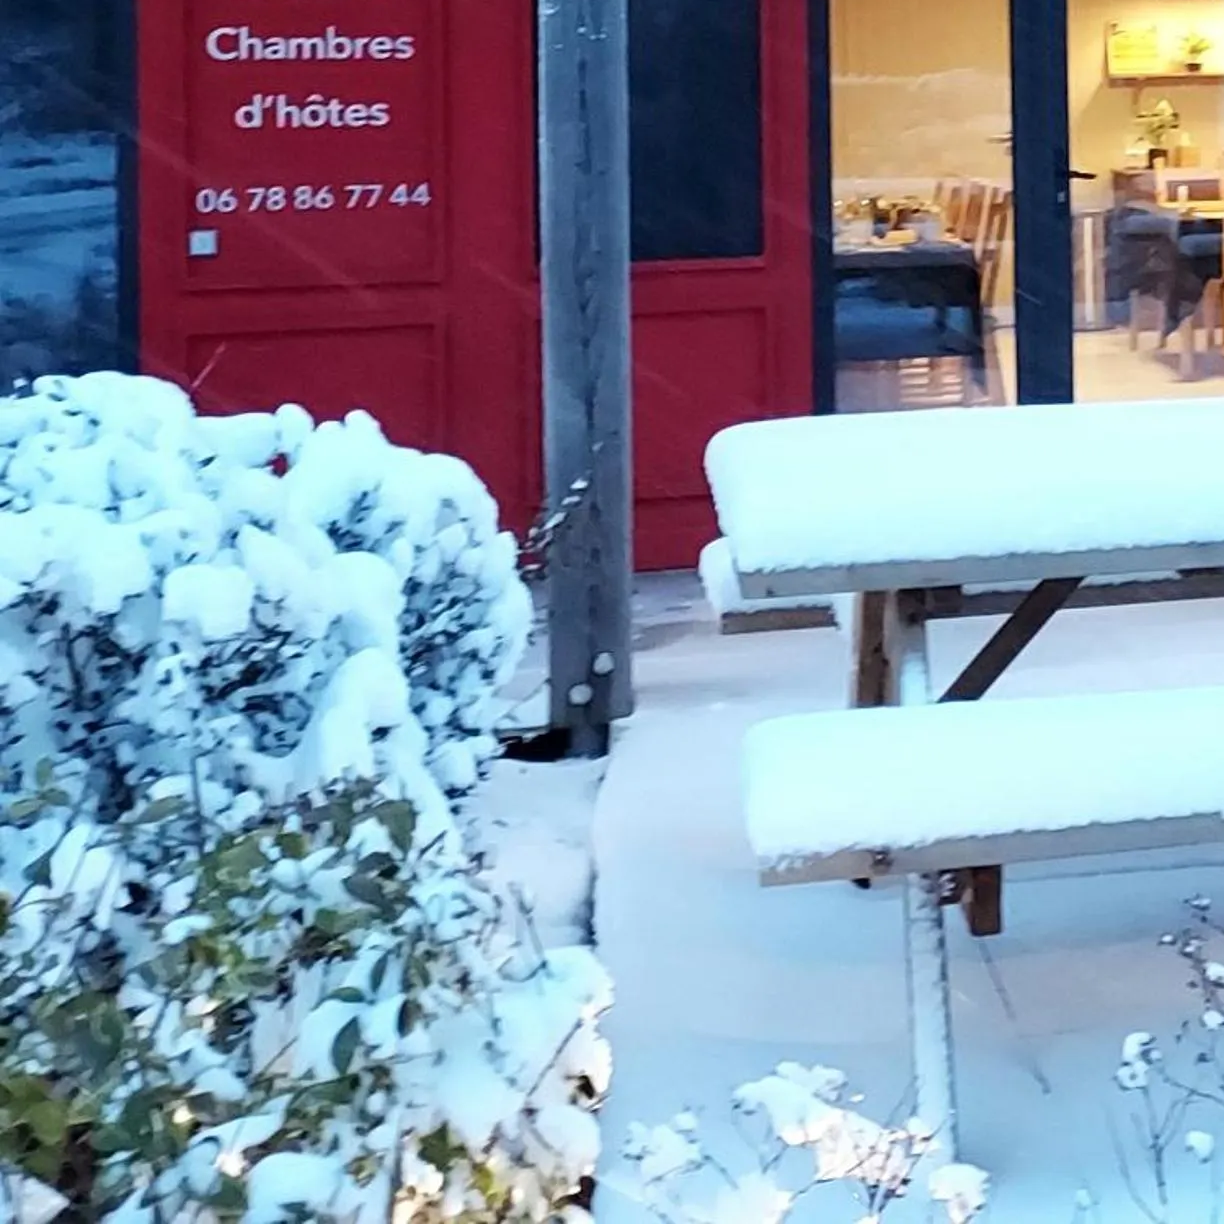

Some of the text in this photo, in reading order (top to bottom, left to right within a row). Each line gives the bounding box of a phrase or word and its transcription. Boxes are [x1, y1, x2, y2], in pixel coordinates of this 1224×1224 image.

[205, 26, 415, 61] Chambres
[195, 182, 432, 213] 06 78 86 77 44
